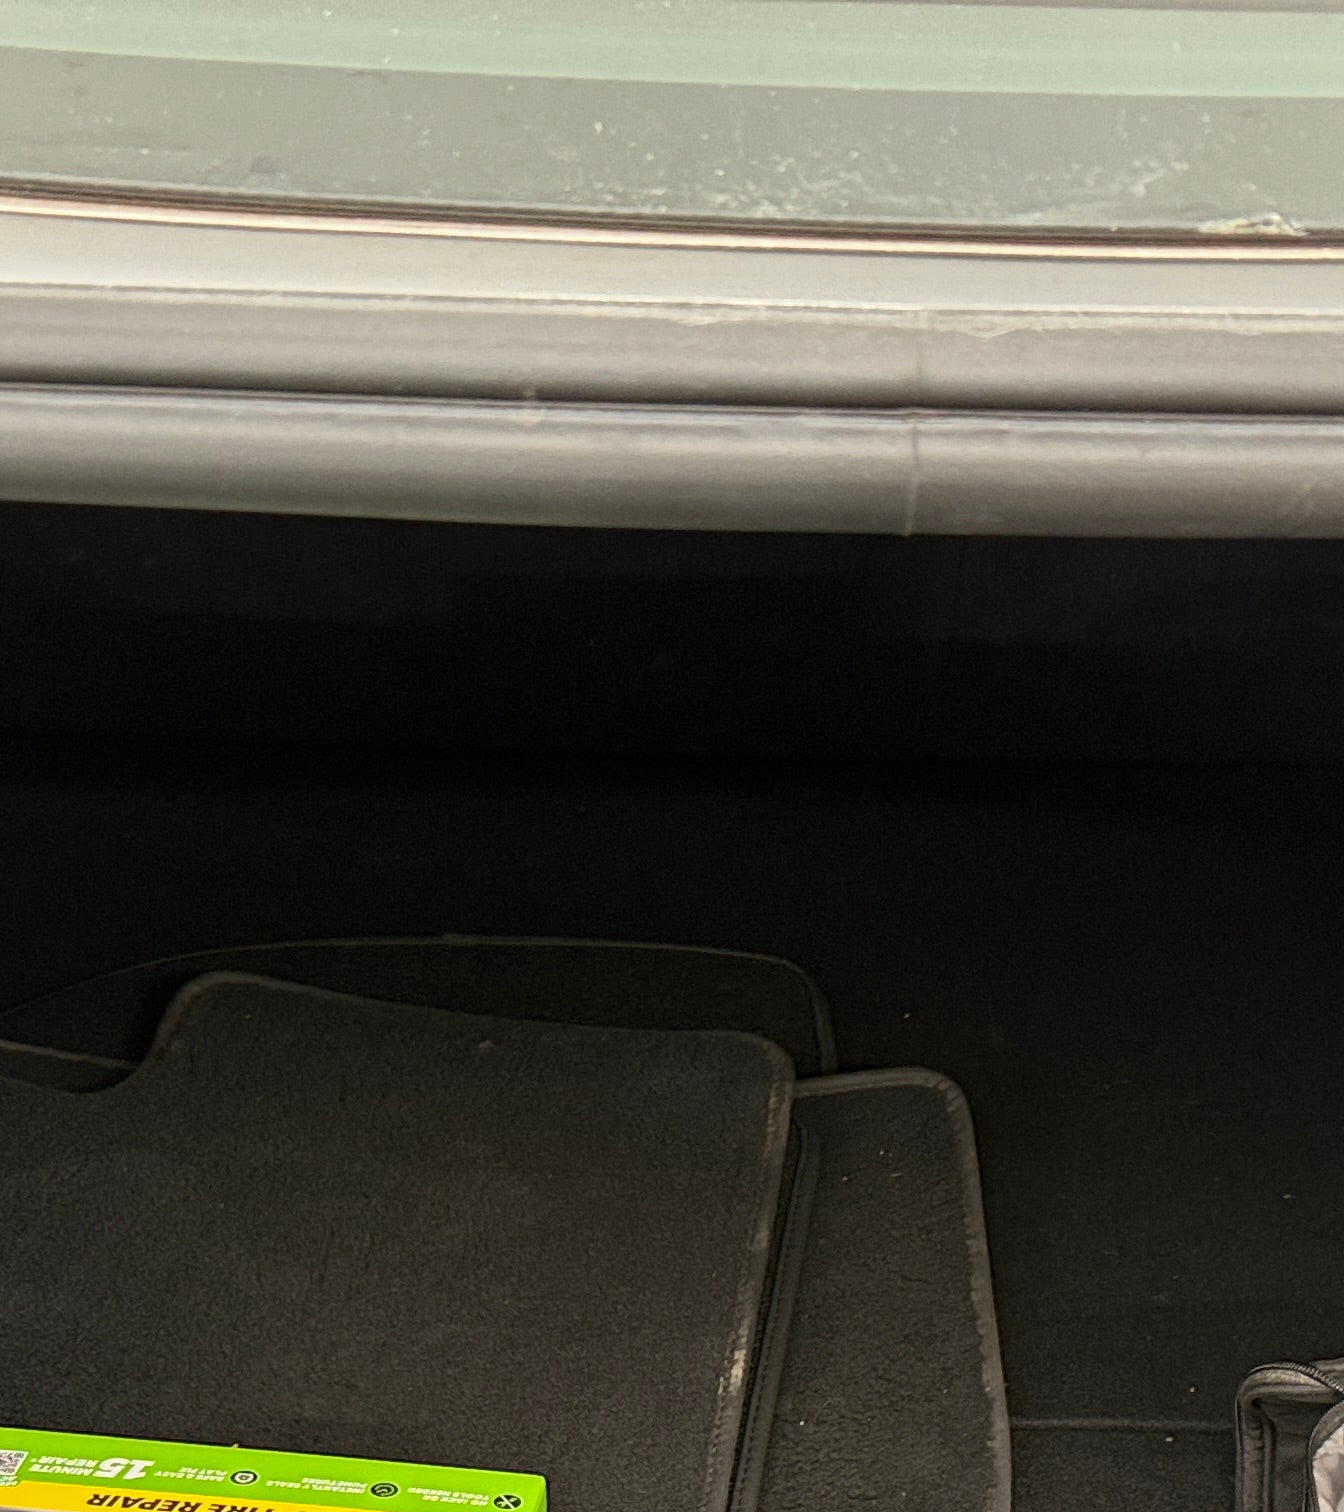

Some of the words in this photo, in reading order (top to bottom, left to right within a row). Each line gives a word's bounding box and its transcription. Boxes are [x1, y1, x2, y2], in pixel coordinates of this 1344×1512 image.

[28, 1464, 94, 1476] MINUTE
[92, 1458, 155, 1480] 15
[301, 1477, 368, 1488] PUNCTURES
[302, 1482, 365, 1494] INSTANTLY
[407, 1487, 452, 1498] NEEDED
[452, 1490, 489, 1500] TOOLS
[440, 1496, 469, 1504] JACK
[471, 1498, 488, 1506] NO
